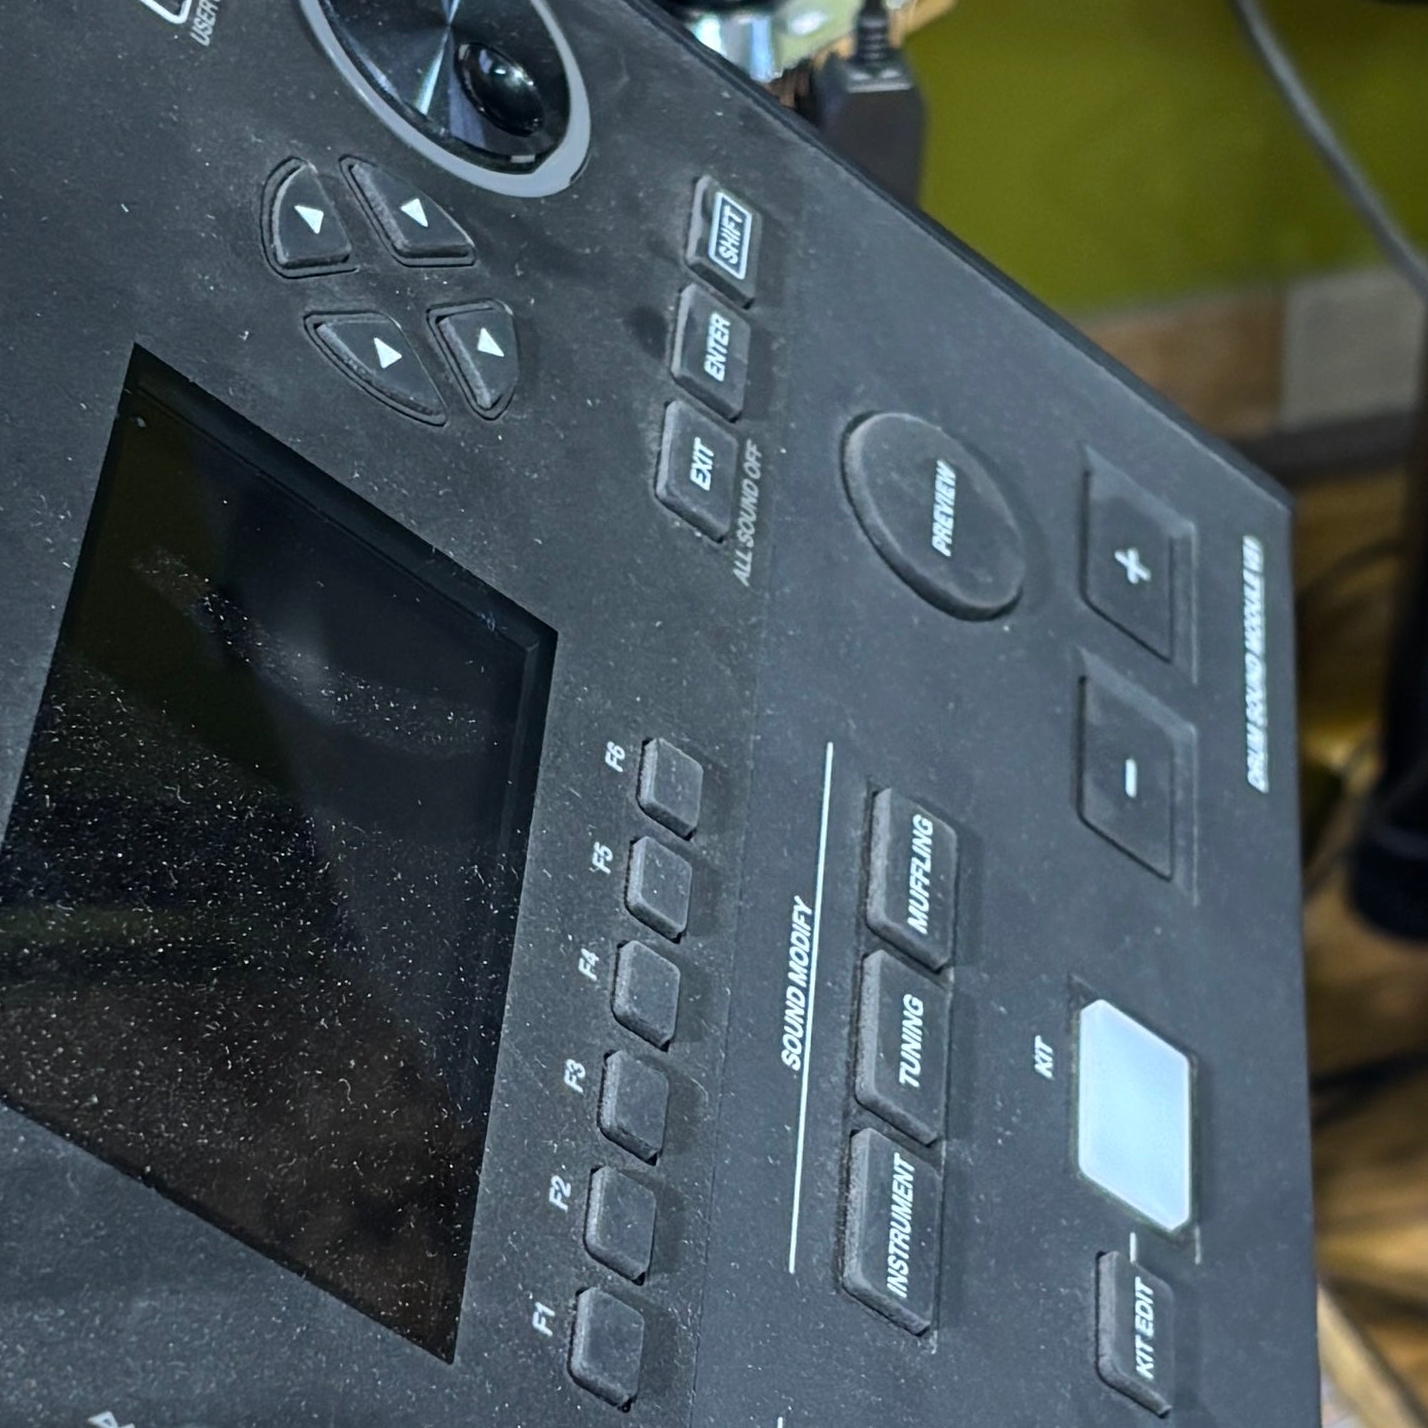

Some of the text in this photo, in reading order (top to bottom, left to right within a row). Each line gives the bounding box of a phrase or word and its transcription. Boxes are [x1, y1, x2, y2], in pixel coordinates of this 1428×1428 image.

[718, 205, 744, 264] SHIFT
[703, 312, 732, 382] ENTER
[689, 437, 715, 491] EXIT
[732, 439, 763, 587] ALL SOUND OFF
[930, 459, 956, 556] PREVIEW
[604, 741, 626, 772] F6
[592, 841, 613, 874] F5
[907, 814, 934, 934] MUFFLING
[578, 948, 599, 981] F4
[782, 896, 812, 1071] SOUND MODIFY
[899, 994, 924, 1089] TUNING
[1034, 1035, 1055, 1079] KIT
[564, 1059, 586, 1094] F3
[549, 1175, 571, 1212] F2
[886, 1153, 917, 1299] INSTRUMENT
[533, 1303, 555, 1337] F1
[1134, 1276, 1154, 1379] KIT EDIT
